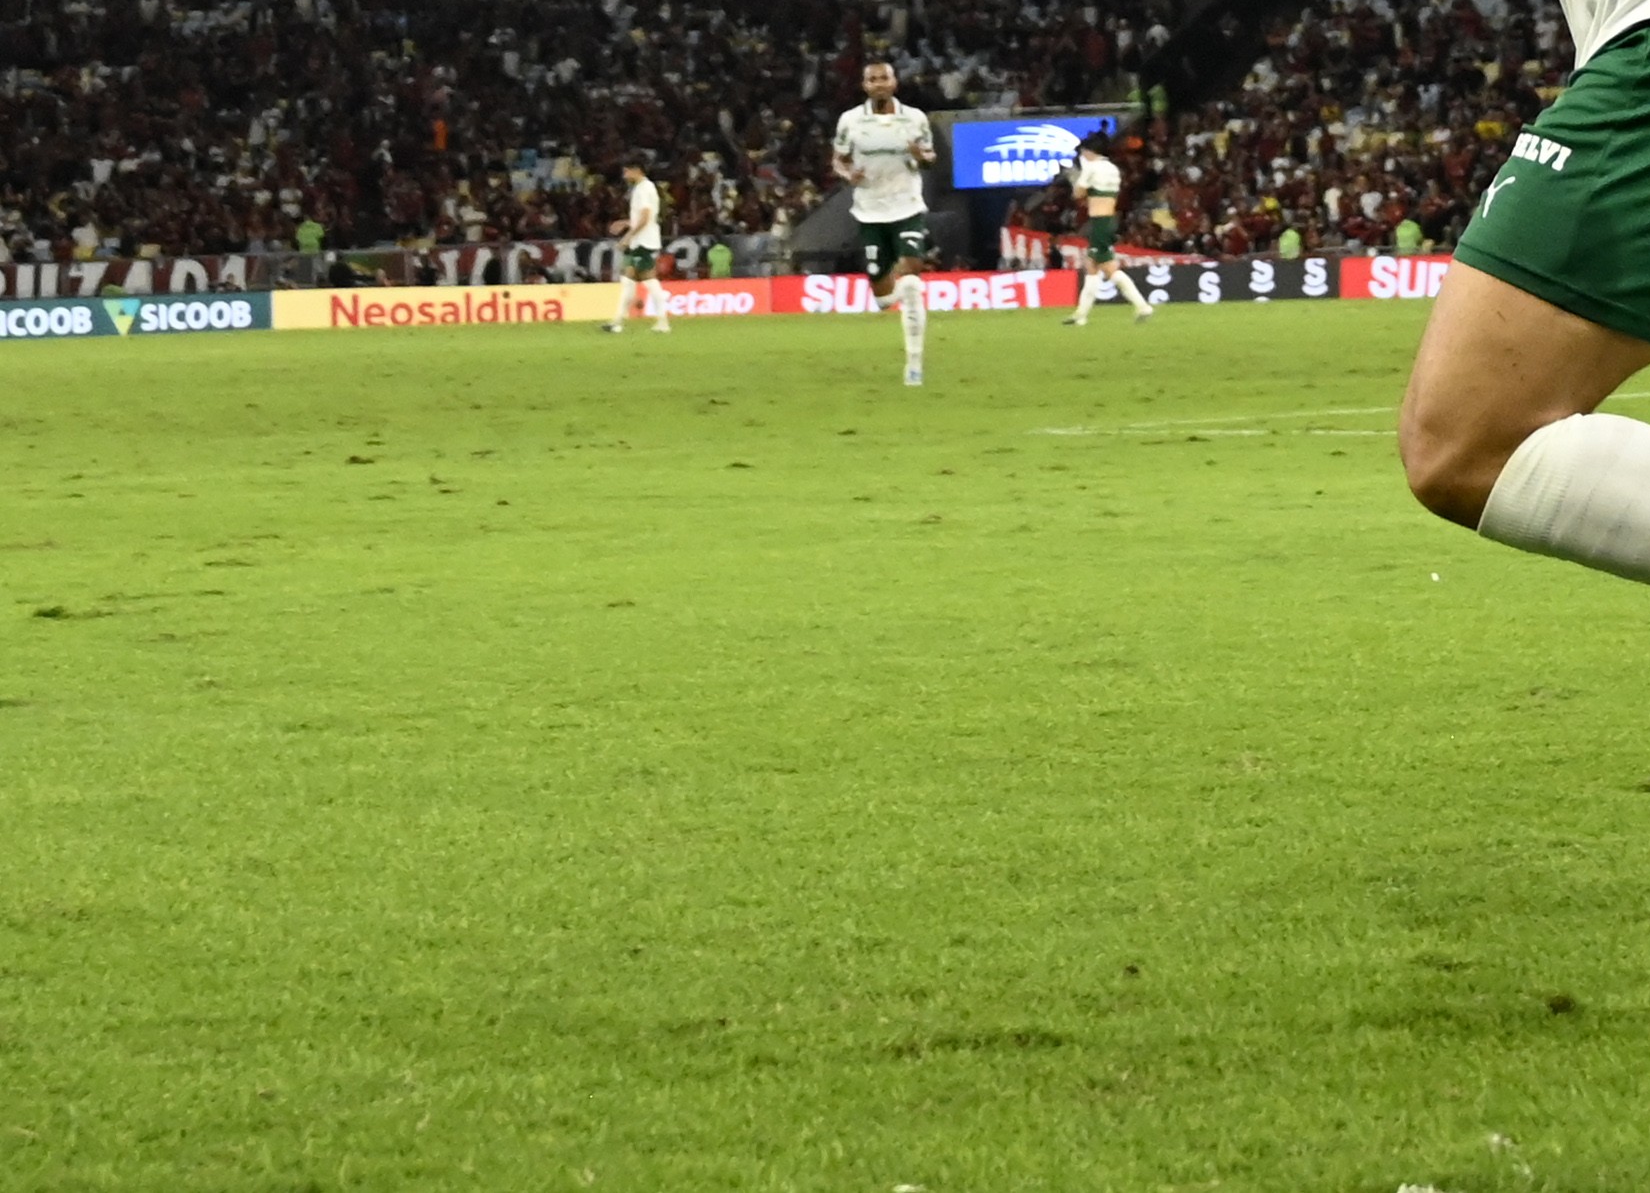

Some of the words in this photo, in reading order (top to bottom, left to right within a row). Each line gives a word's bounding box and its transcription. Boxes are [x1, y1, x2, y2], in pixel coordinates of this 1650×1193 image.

[801, 270, 1046, 313] SURBET
[140, 300, 252, 332] SICOOB
[330, 292, 564, 328] Neosaldina
